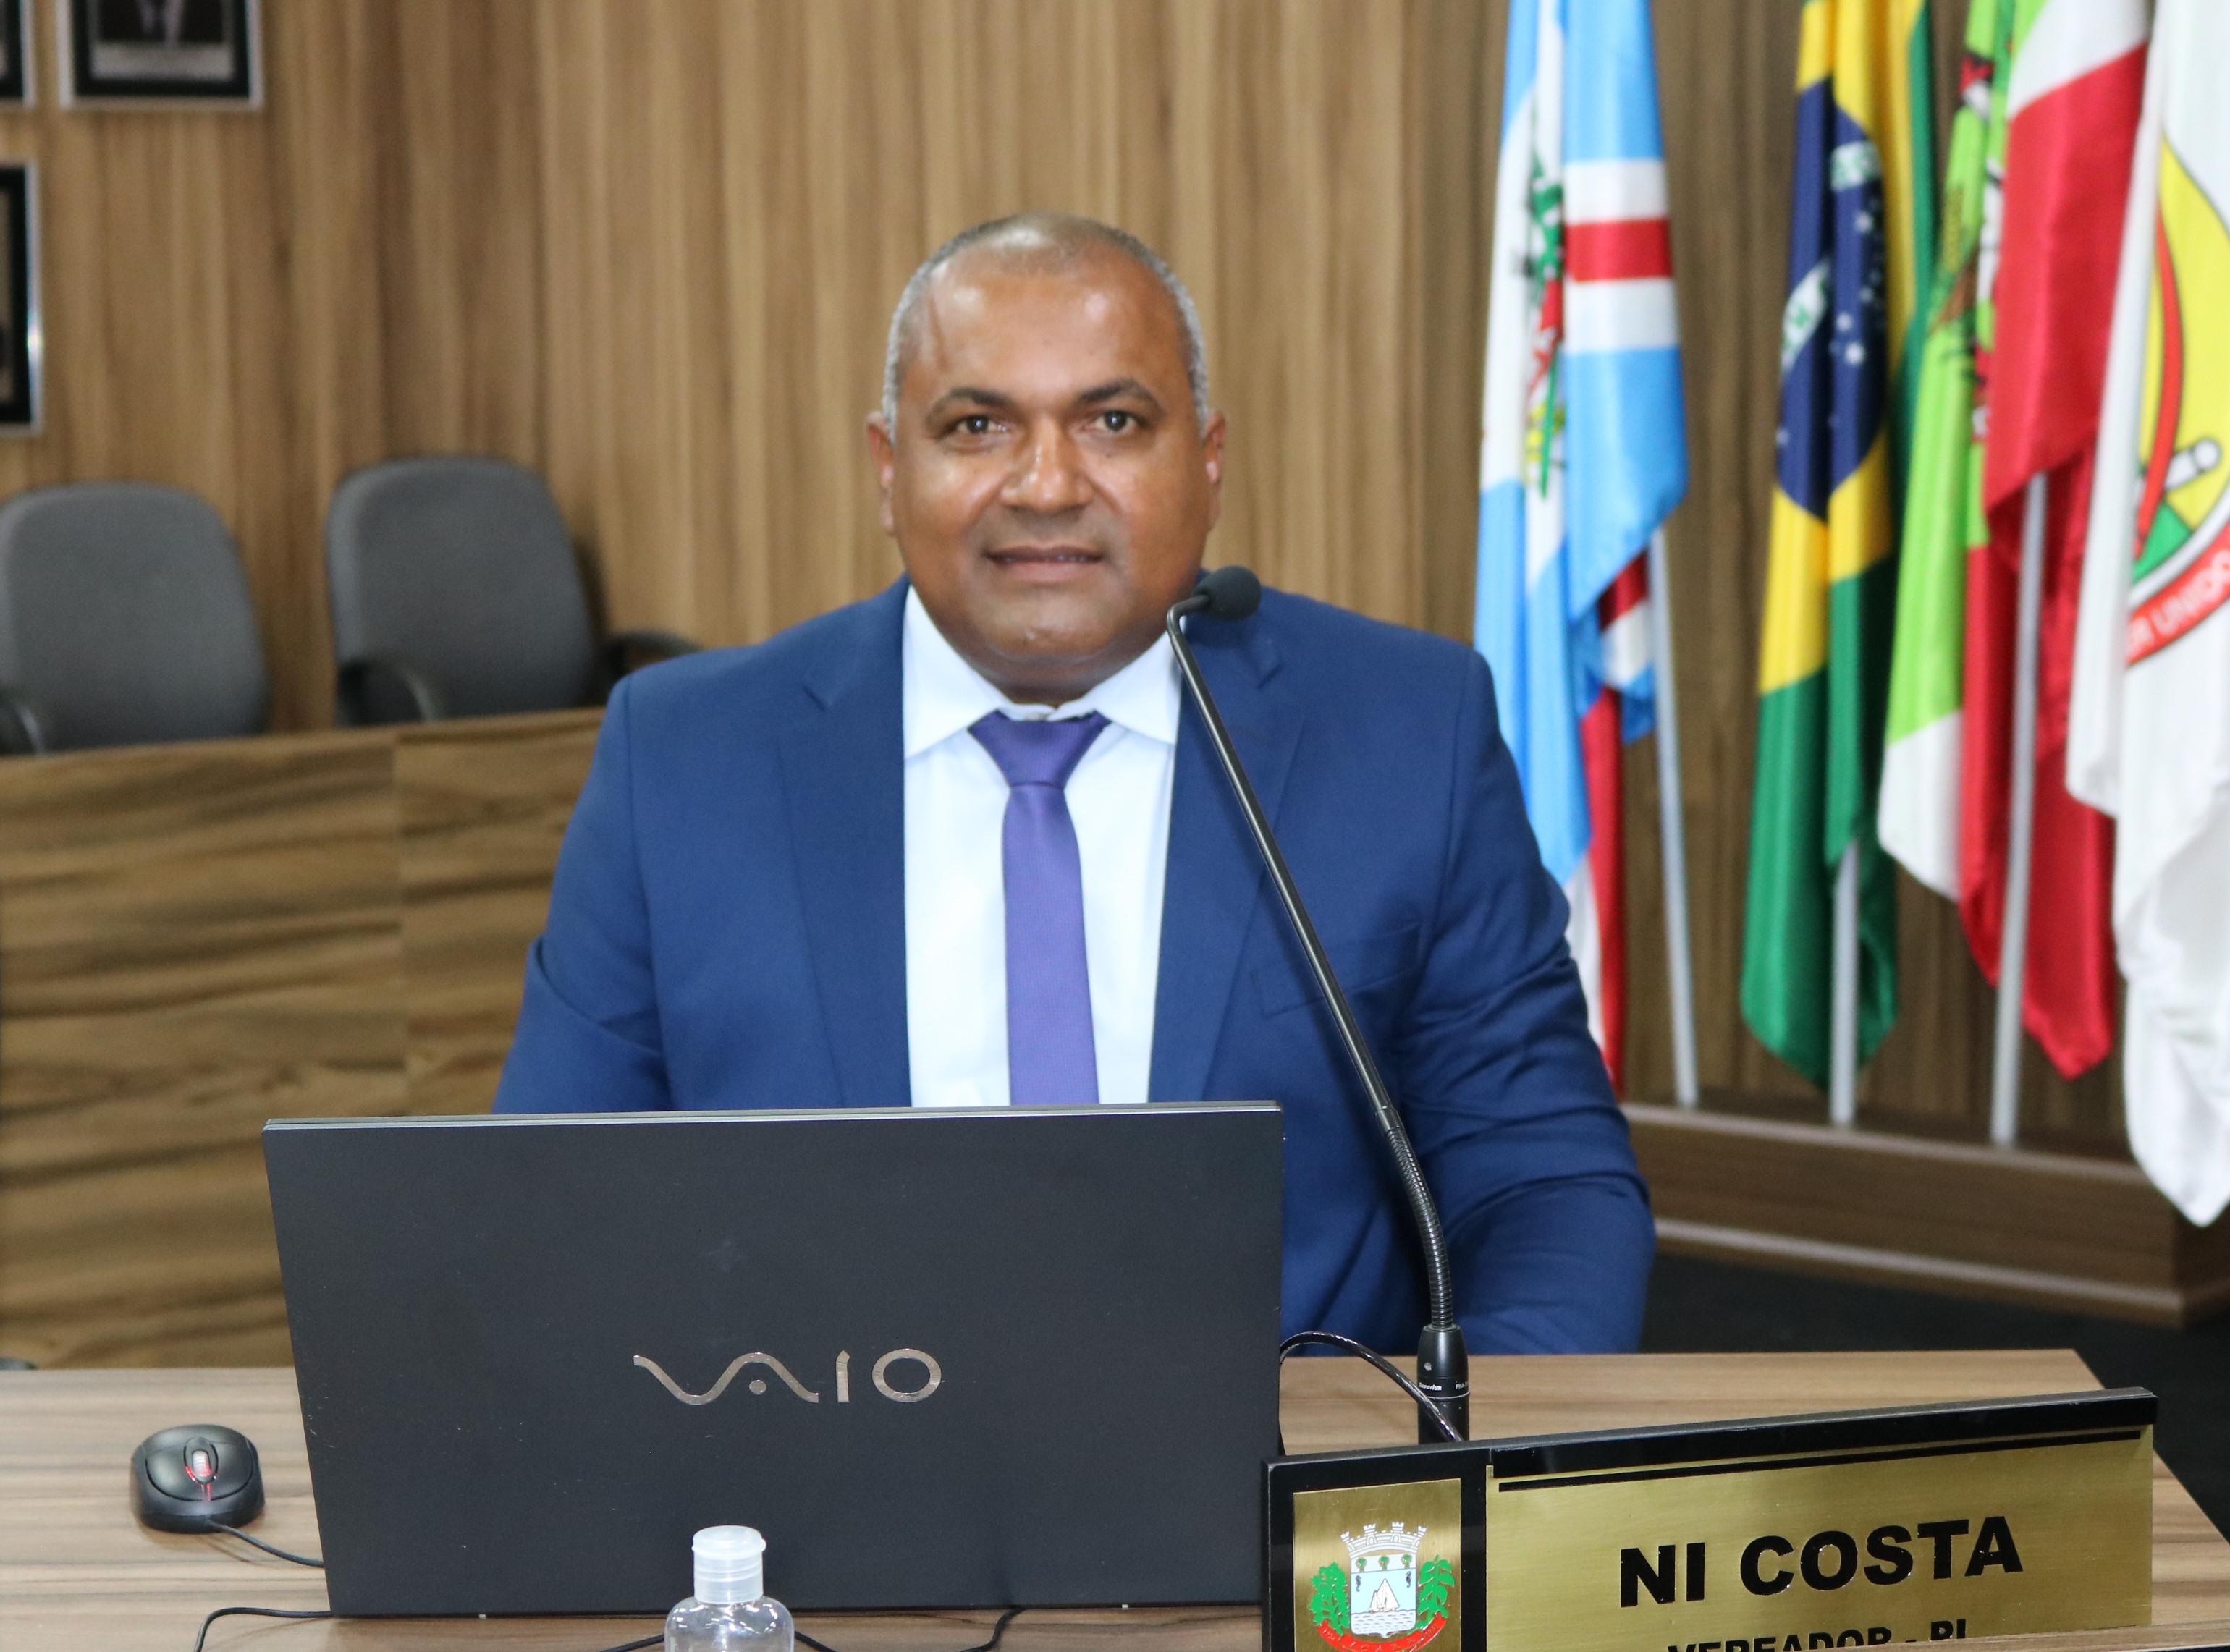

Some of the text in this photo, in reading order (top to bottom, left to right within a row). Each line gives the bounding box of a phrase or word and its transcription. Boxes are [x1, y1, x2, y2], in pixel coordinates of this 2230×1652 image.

[633, 1348, 942, 1405] VAIO
[1621, 1516, 2024, 1607] NI COSTA
